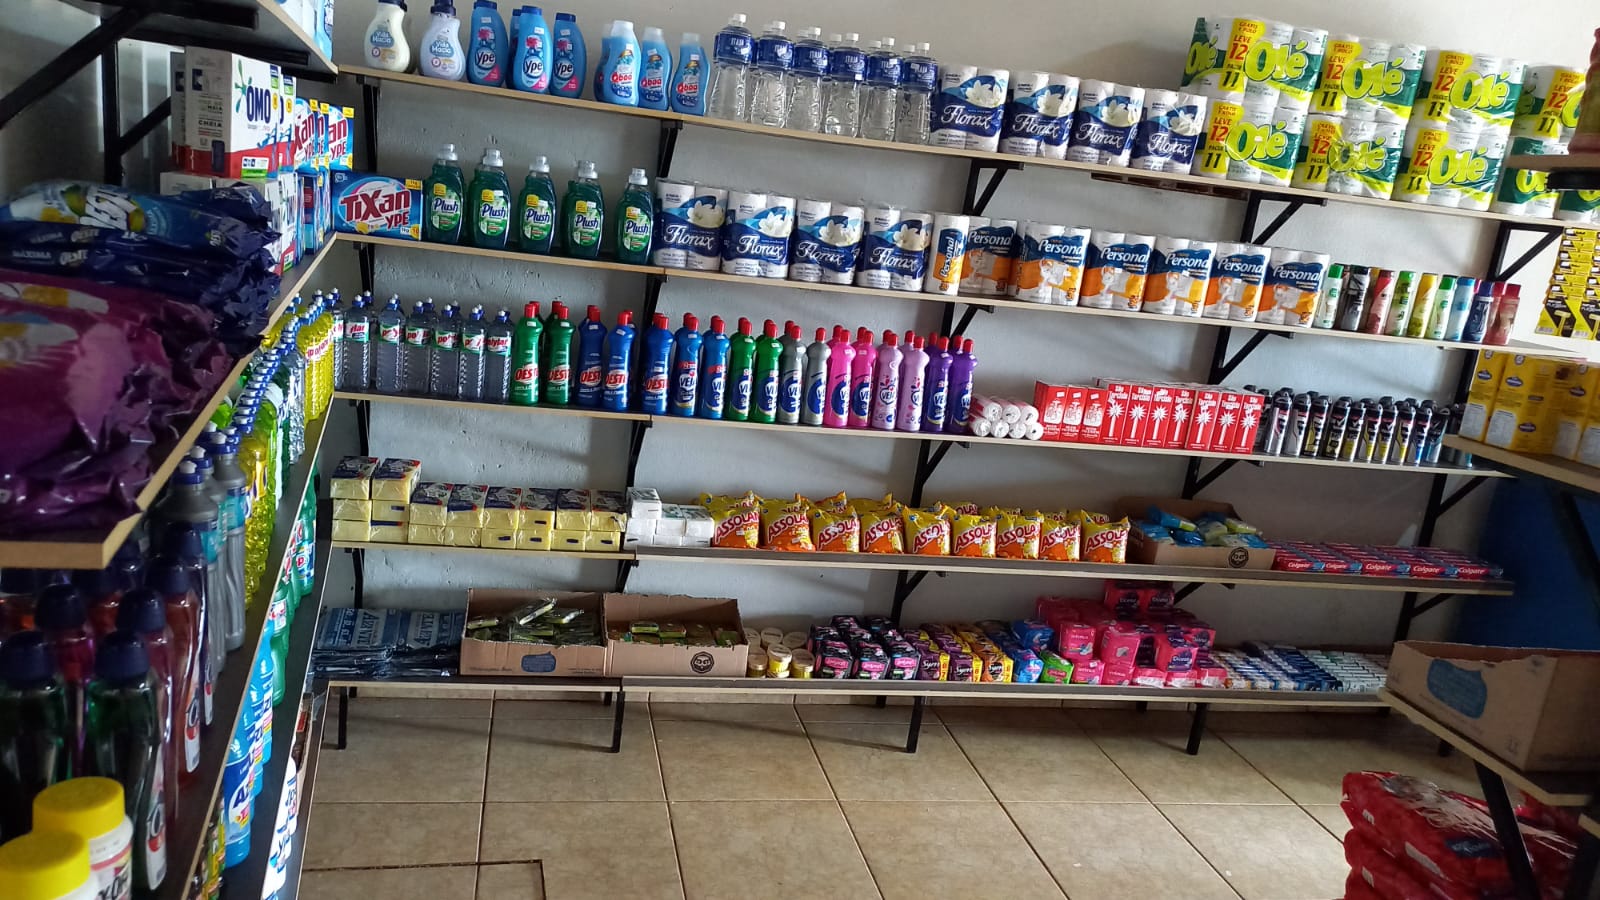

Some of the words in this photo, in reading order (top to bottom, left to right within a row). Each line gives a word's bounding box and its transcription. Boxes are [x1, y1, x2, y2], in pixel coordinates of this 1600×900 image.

[1228, 42, 1249, 61] 12
[1244, 40, 1309, 82] Olé
[1222, 71, 1240, 88] 11
[1325, 63, 1344, 80] 12
[1341, 56, 1404, 99] Olé
[1439, 67, 1459, 76] LEVE
[1434, 74, 1455, 91] 12
[1449, 71, 1510, 111] Olé
[246, 85, 272, 124] OMO
[1320, 91, 1338, 107] 11
[1547, 92, 1568, 109] 12
[941, 104, 991, 129] Florax
[1012, 113, 1061, 140] Florax
[1209, 125, 1229, 142] 12
[1225, 120, 1288, 161] Olé
[1311, 138, 1330, 155] 12
[1204, 152, 1222, 169] 11
[1412, 150, 1433, 167] 12
[1427, 146, 1489, 186] Olé
[433, 197, 458, 213] Plush
[481, 203, 506, 218] Plush
[525, 208, 550, 225] Plush
[574, 214, 599, 230] Plush
[625, 221, 649, 235] Plush
[736, 234, 783, 260] Florax
[869, 245, 918, 272] Florax
[1287, 561, 1311, 570] Colgate
[1325, 562, 1347, 570] Colgate
[1365, 563, 1393, 572] Colgate
[1412, 565, 1440, 574] Colgate
[1457, 566, 1485, 575] Colgate
